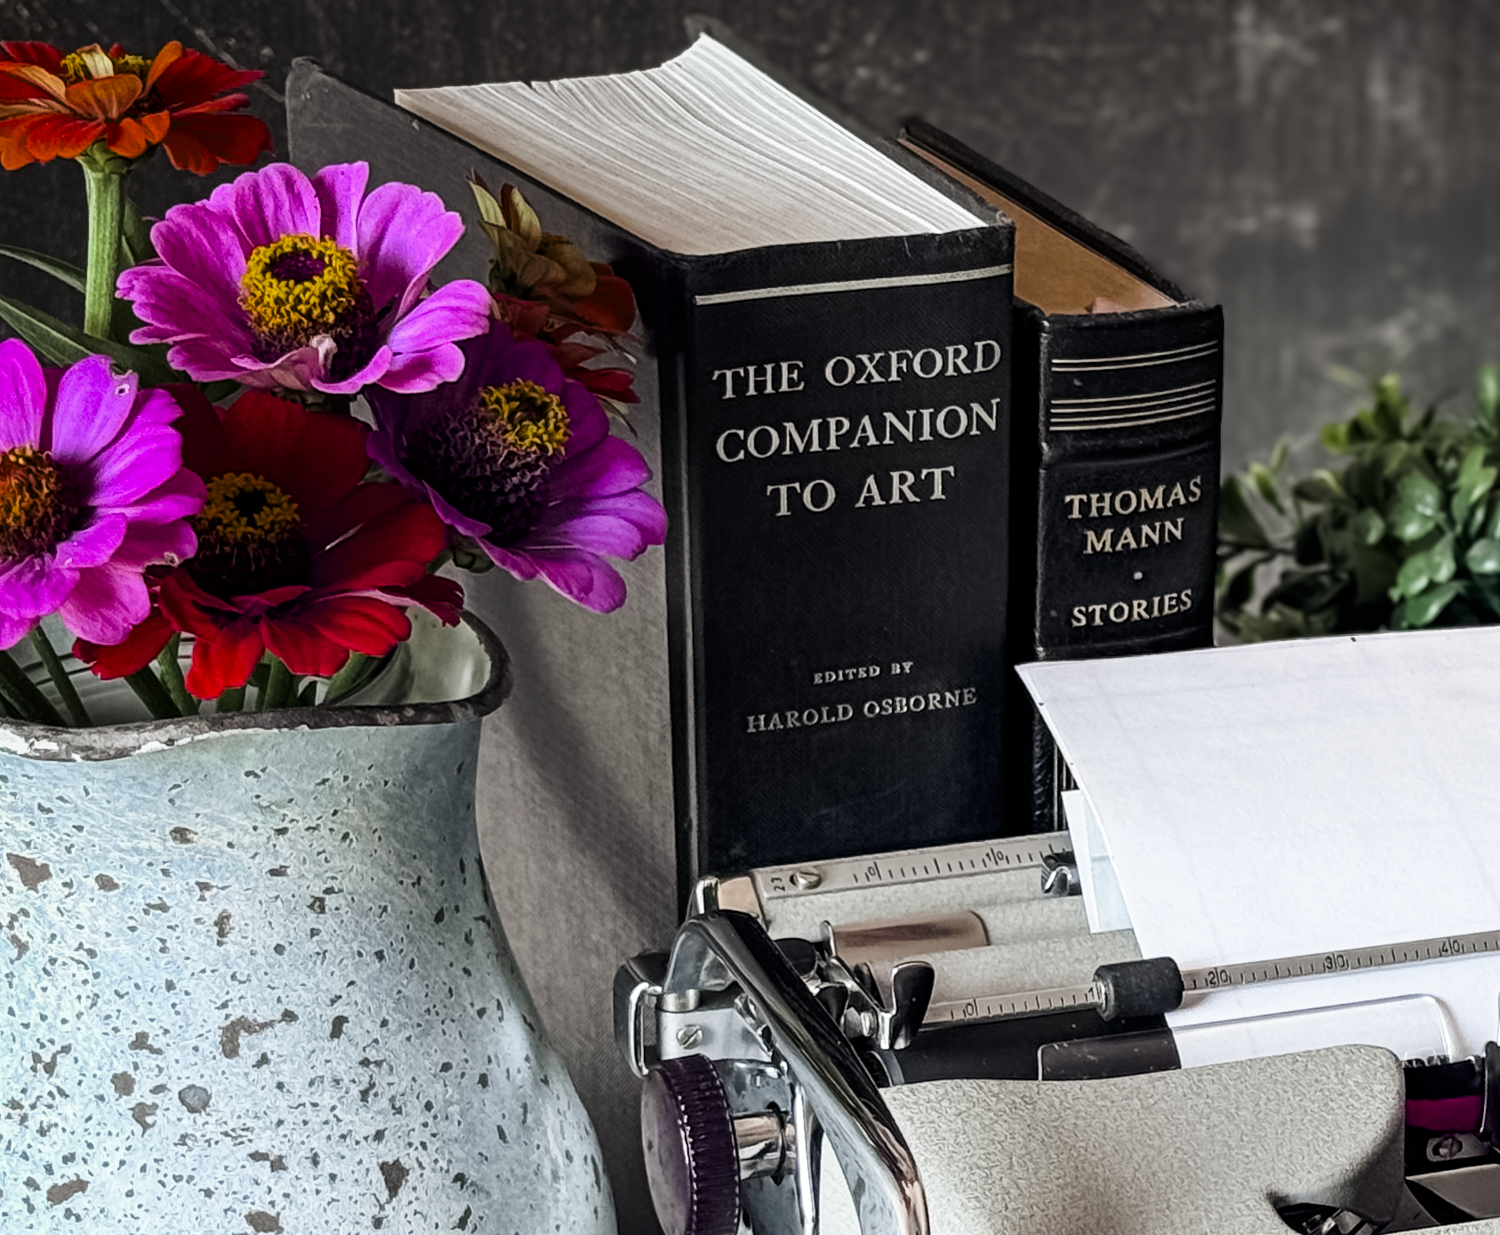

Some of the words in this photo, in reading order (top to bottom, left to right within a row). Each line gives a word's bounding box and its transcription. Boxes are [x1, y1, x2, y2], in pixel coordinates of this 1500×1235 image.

[713, 361, 805, 400] THE
[824, 339, 1001, 387] OXFORD
[716, 398, 1001, 463] COMPANION
[767, 478, 836, 517] TO
[855, 466, 955, 508] ART
[1064, 476, 1201, 520] THOMAS
[1083, 517, 1184, 555] MANN
[1070, 589, 1193, 628] STORIES
[813, 664, 881, 685] EDITED
[891, 661, 914, 675] BY
[747, 702, 854, 733] HAROLD
[863, 687, 978, 718] OSBORNE
